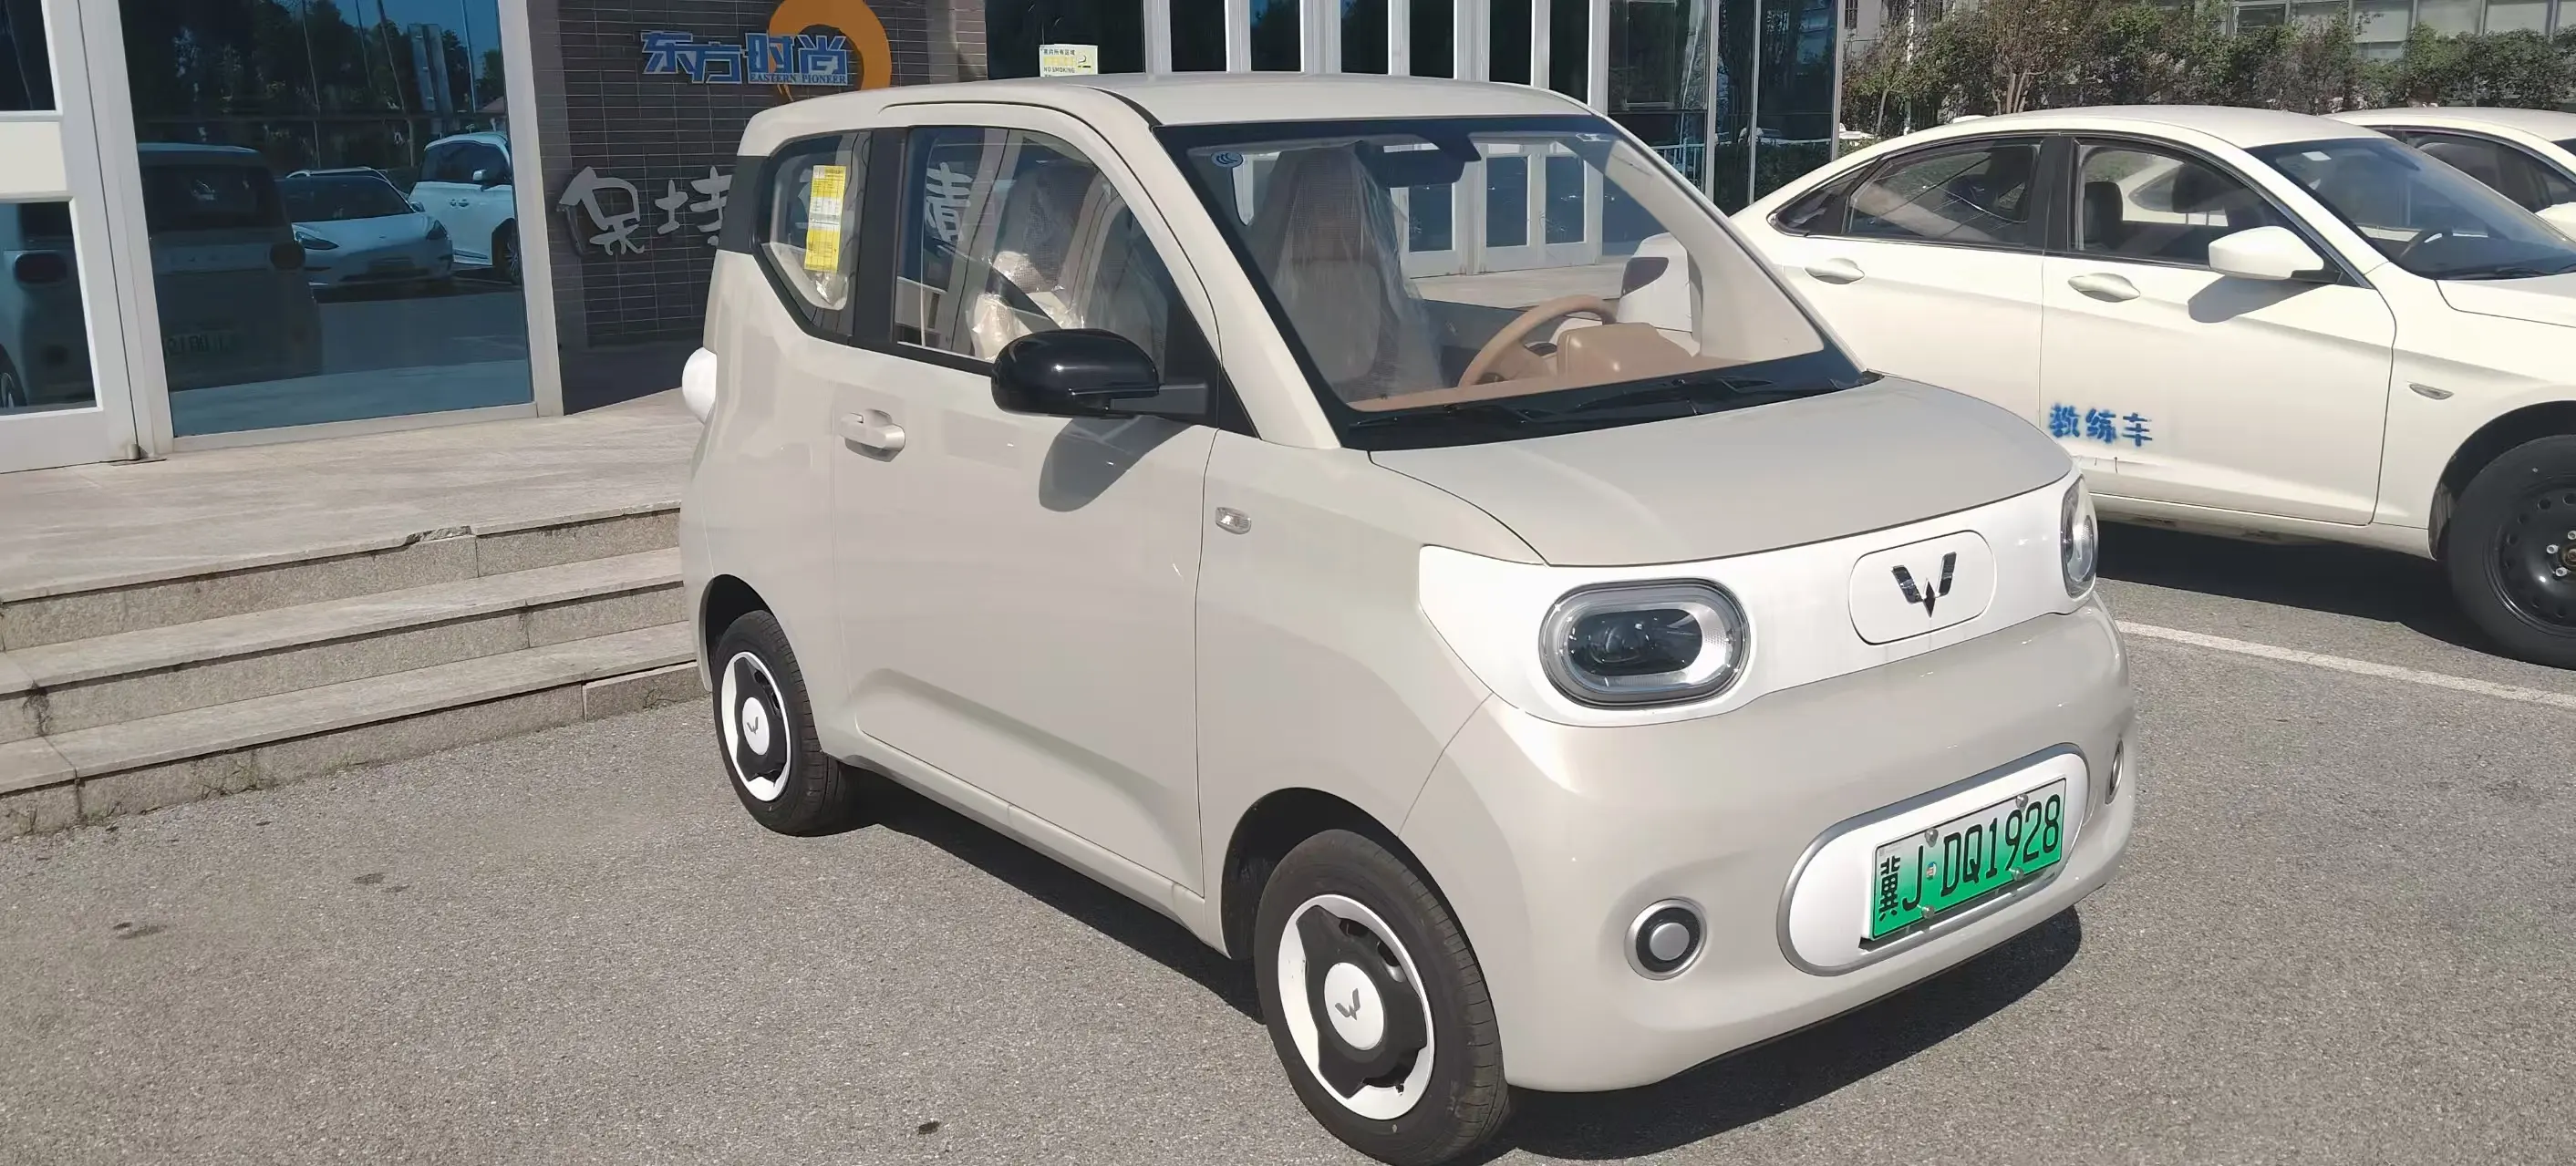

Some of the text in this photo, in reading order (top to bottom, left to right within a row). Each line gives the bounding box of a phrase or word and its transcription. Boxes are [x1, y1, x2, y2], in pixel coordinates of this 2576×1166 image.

[640, 30, 847, 84] 东方时尚
[750, 73, 847, 84] EASTERN PIONEER
[2049, 403, 2153, 448] 教练车
